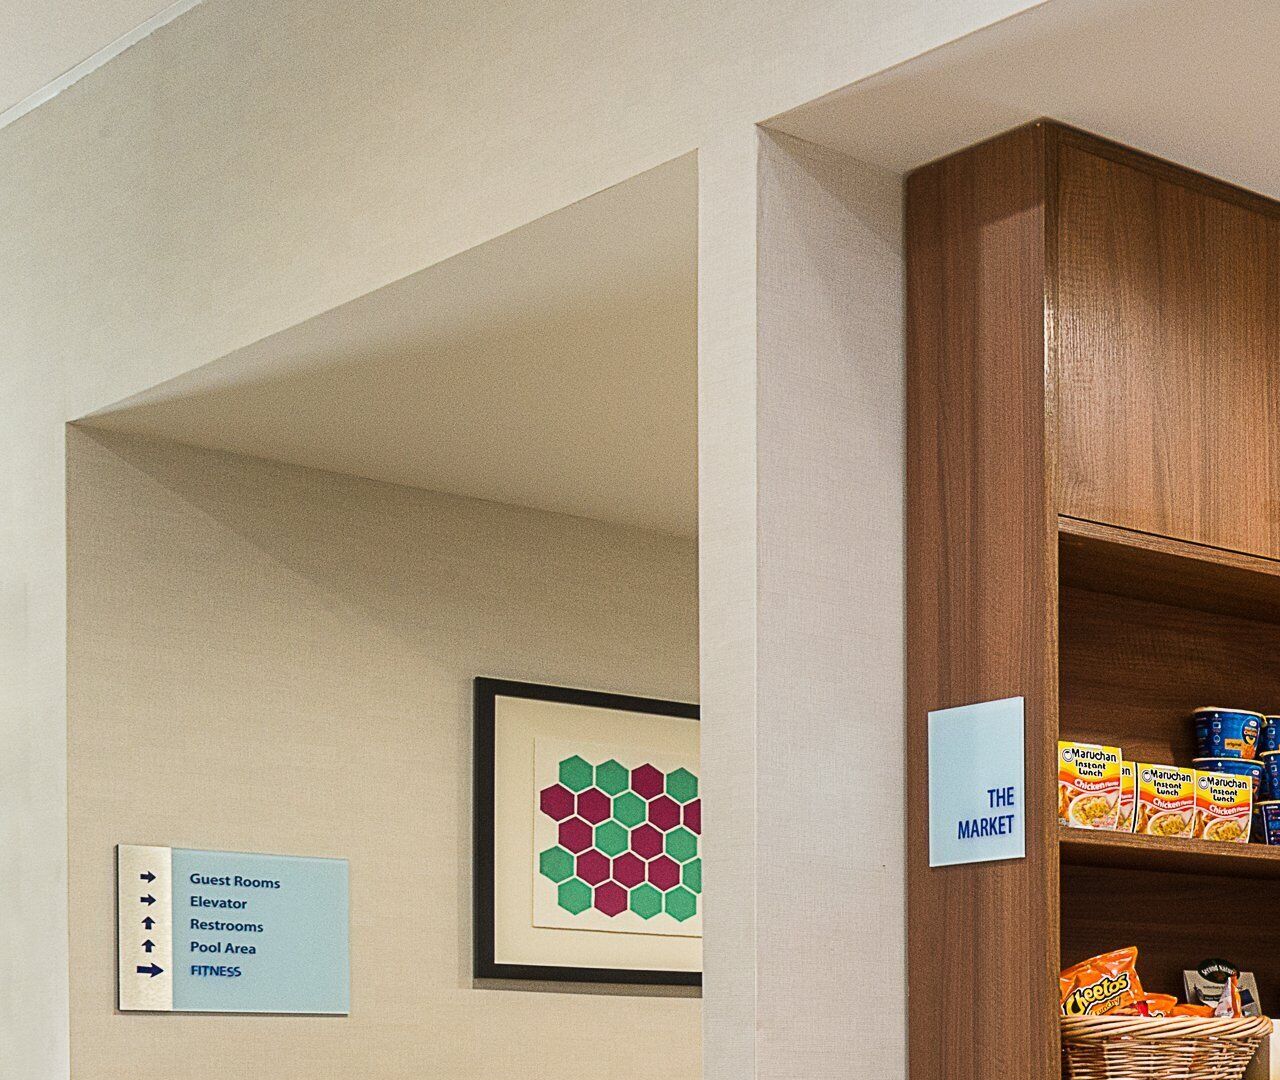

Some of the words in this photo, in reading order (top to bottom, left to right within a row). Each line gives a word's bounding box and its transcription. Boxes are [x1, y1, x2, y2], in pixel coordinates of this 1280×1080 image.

[1071, 748, 1117, 762] Maruchan
[1075, 760, 1106, 770] Instant
[1079, 768, 1103, 777] Lunch
[1151, 769, 1192, 782] Maruchan
[1074, 778, 1105, 790] Chicken
[1154, 780, 1182, 789] Instant
[1207, 776, 1248, 789] Maruchan
[987, 786, 1014, 808] THE
[1157, 788, 1179, 796] Lunch
[1210, 787, 1237, 796] Instant
[1213, 795, 1235, 803] Lunch
[958, 814, 1014, 840] MARKET
[190, 873, 231, 887] Guest
[234, 876, 281, 889] Rooms
[190, 896, 248, 910] Elevator
[190, 918, 264, 933] Restrooms
[190, 941, 222, 953] Pool
[225, 943, 256, 955] Area
[190, 965, 242, 978] FITNESS
[1063, 972, 1130, 1015] Cheetos
